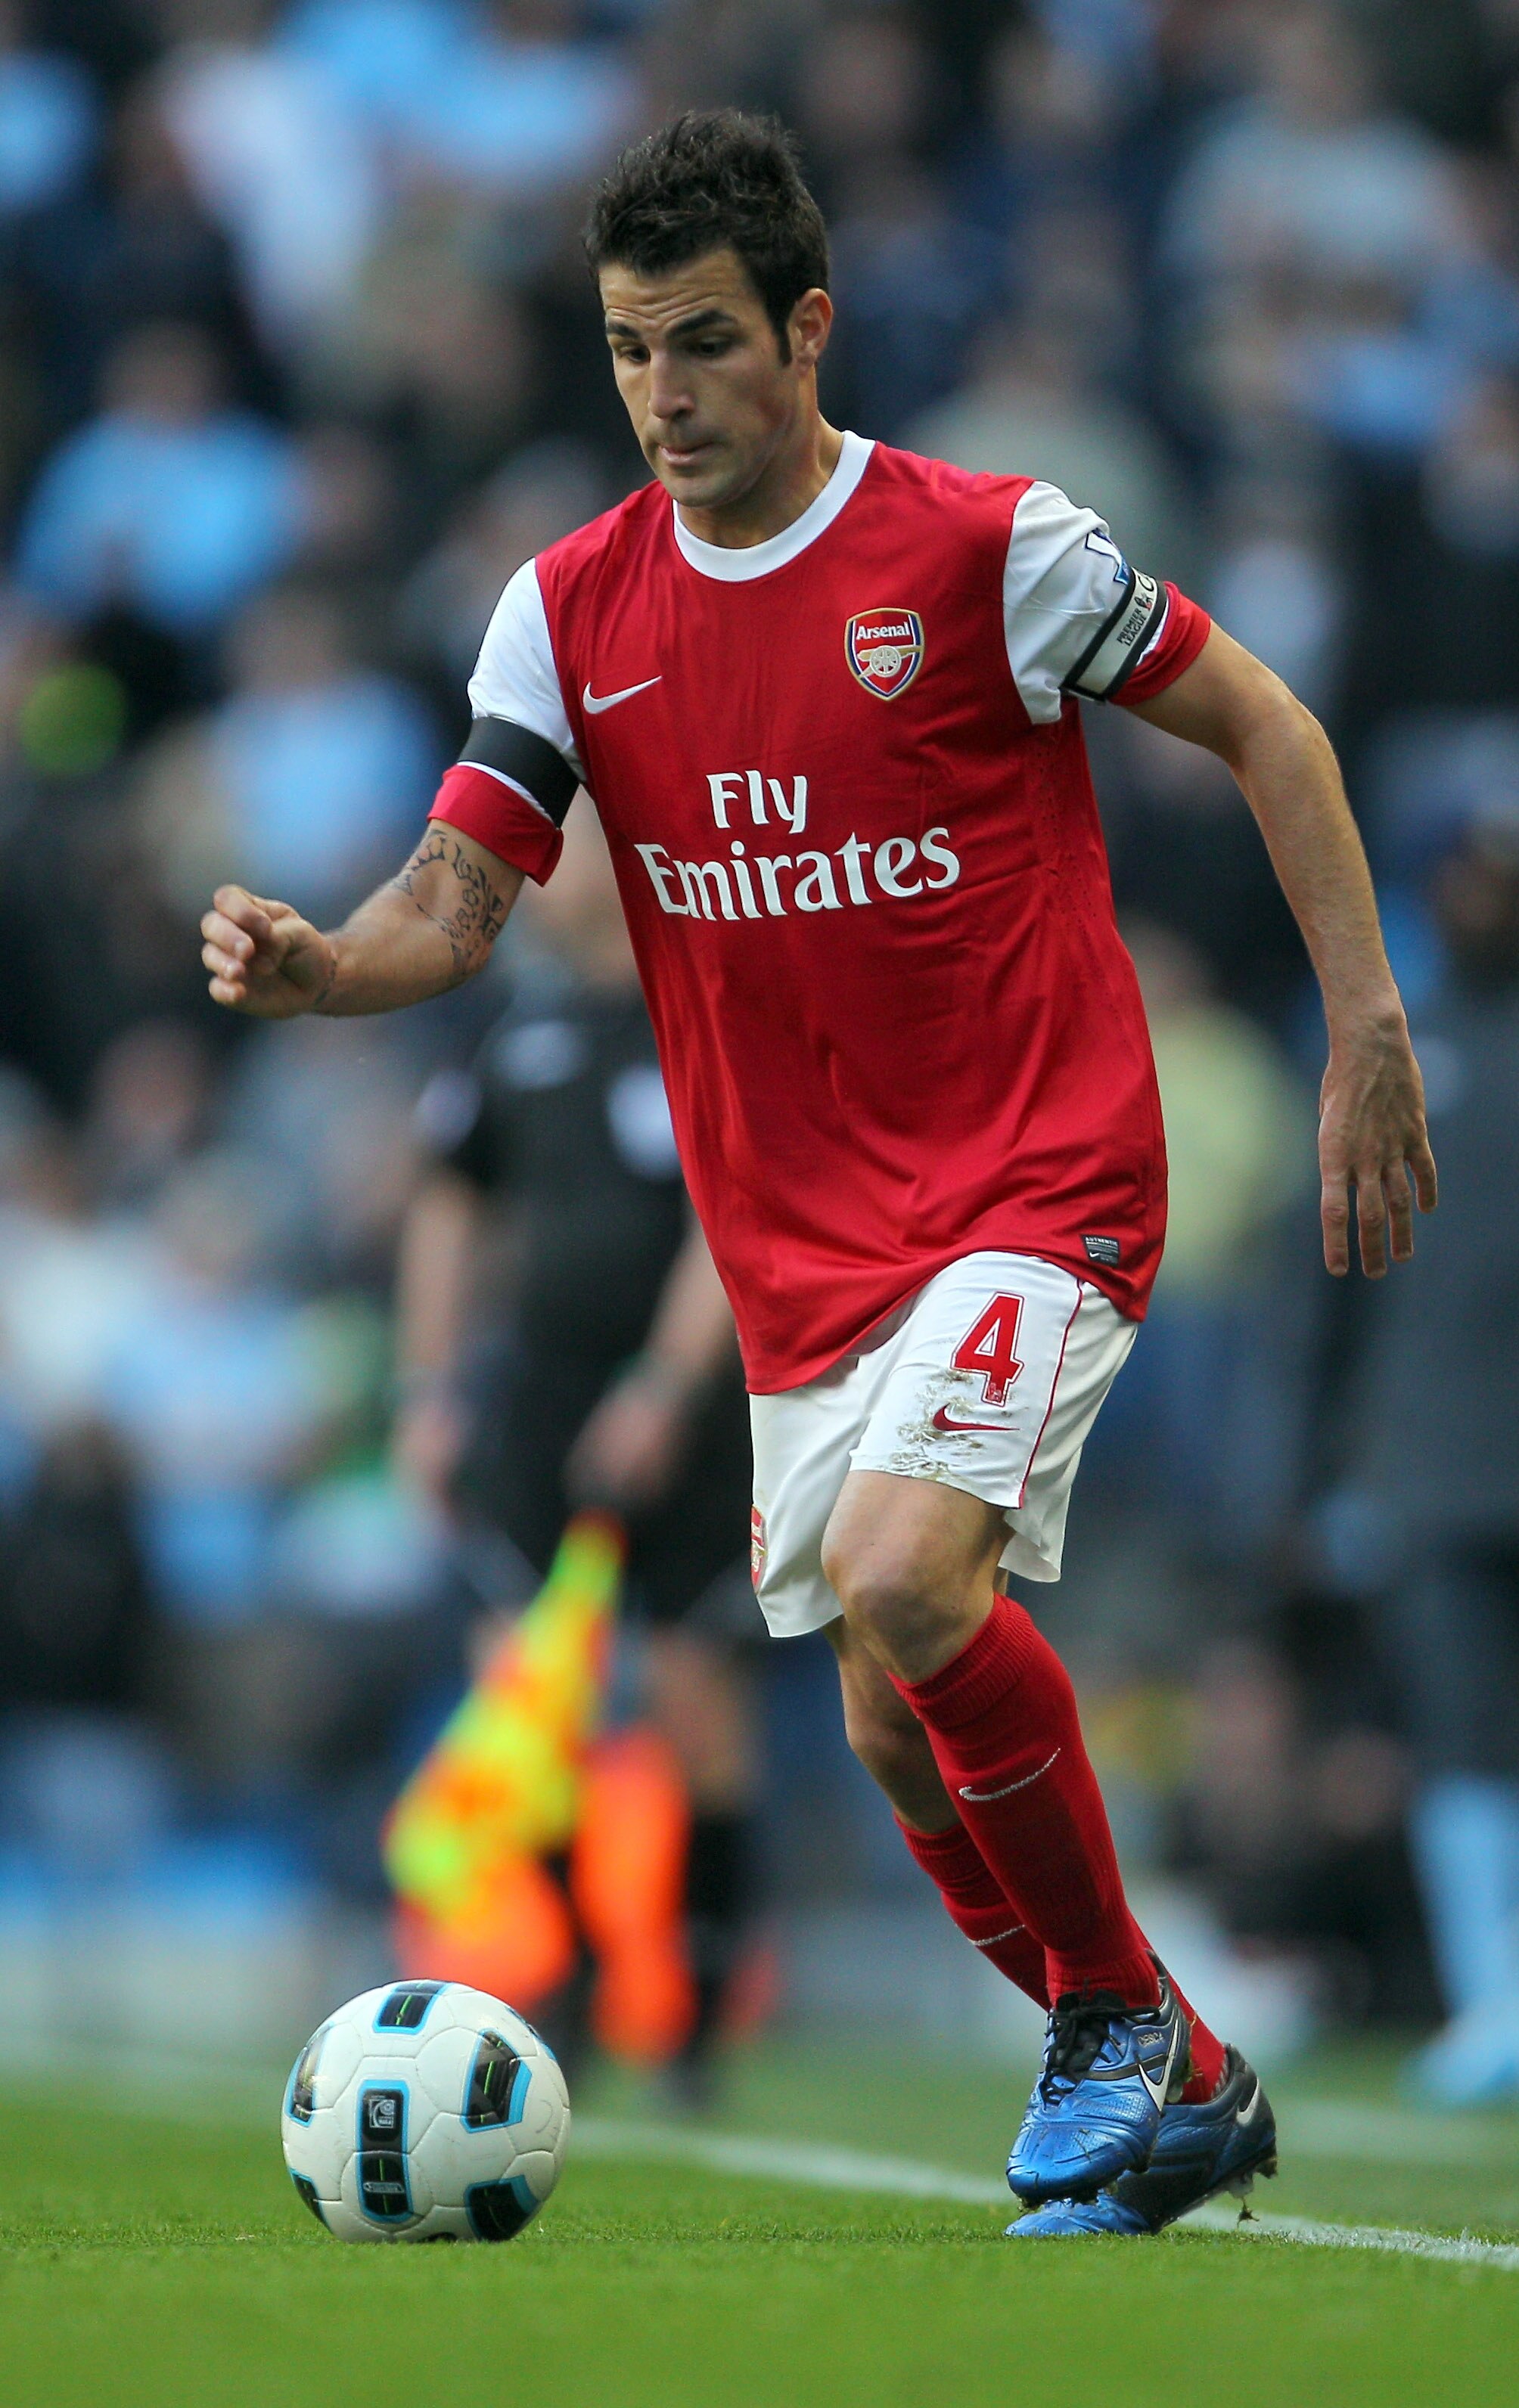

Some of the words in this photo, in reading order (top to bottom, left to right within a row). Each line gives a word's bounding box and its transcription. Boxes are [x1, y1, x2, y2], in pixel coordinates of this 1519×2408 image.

[856, 621, 911, 641] Arsenal
[1117, 607, 1143, 644] PREMIER
[1123, 615, 1147, 647] LEAGUE
[705, 769, 808, 834] Fly
[634, 827, 961, 921] Emirates
[949, 1291, 1025, 1407] 4
